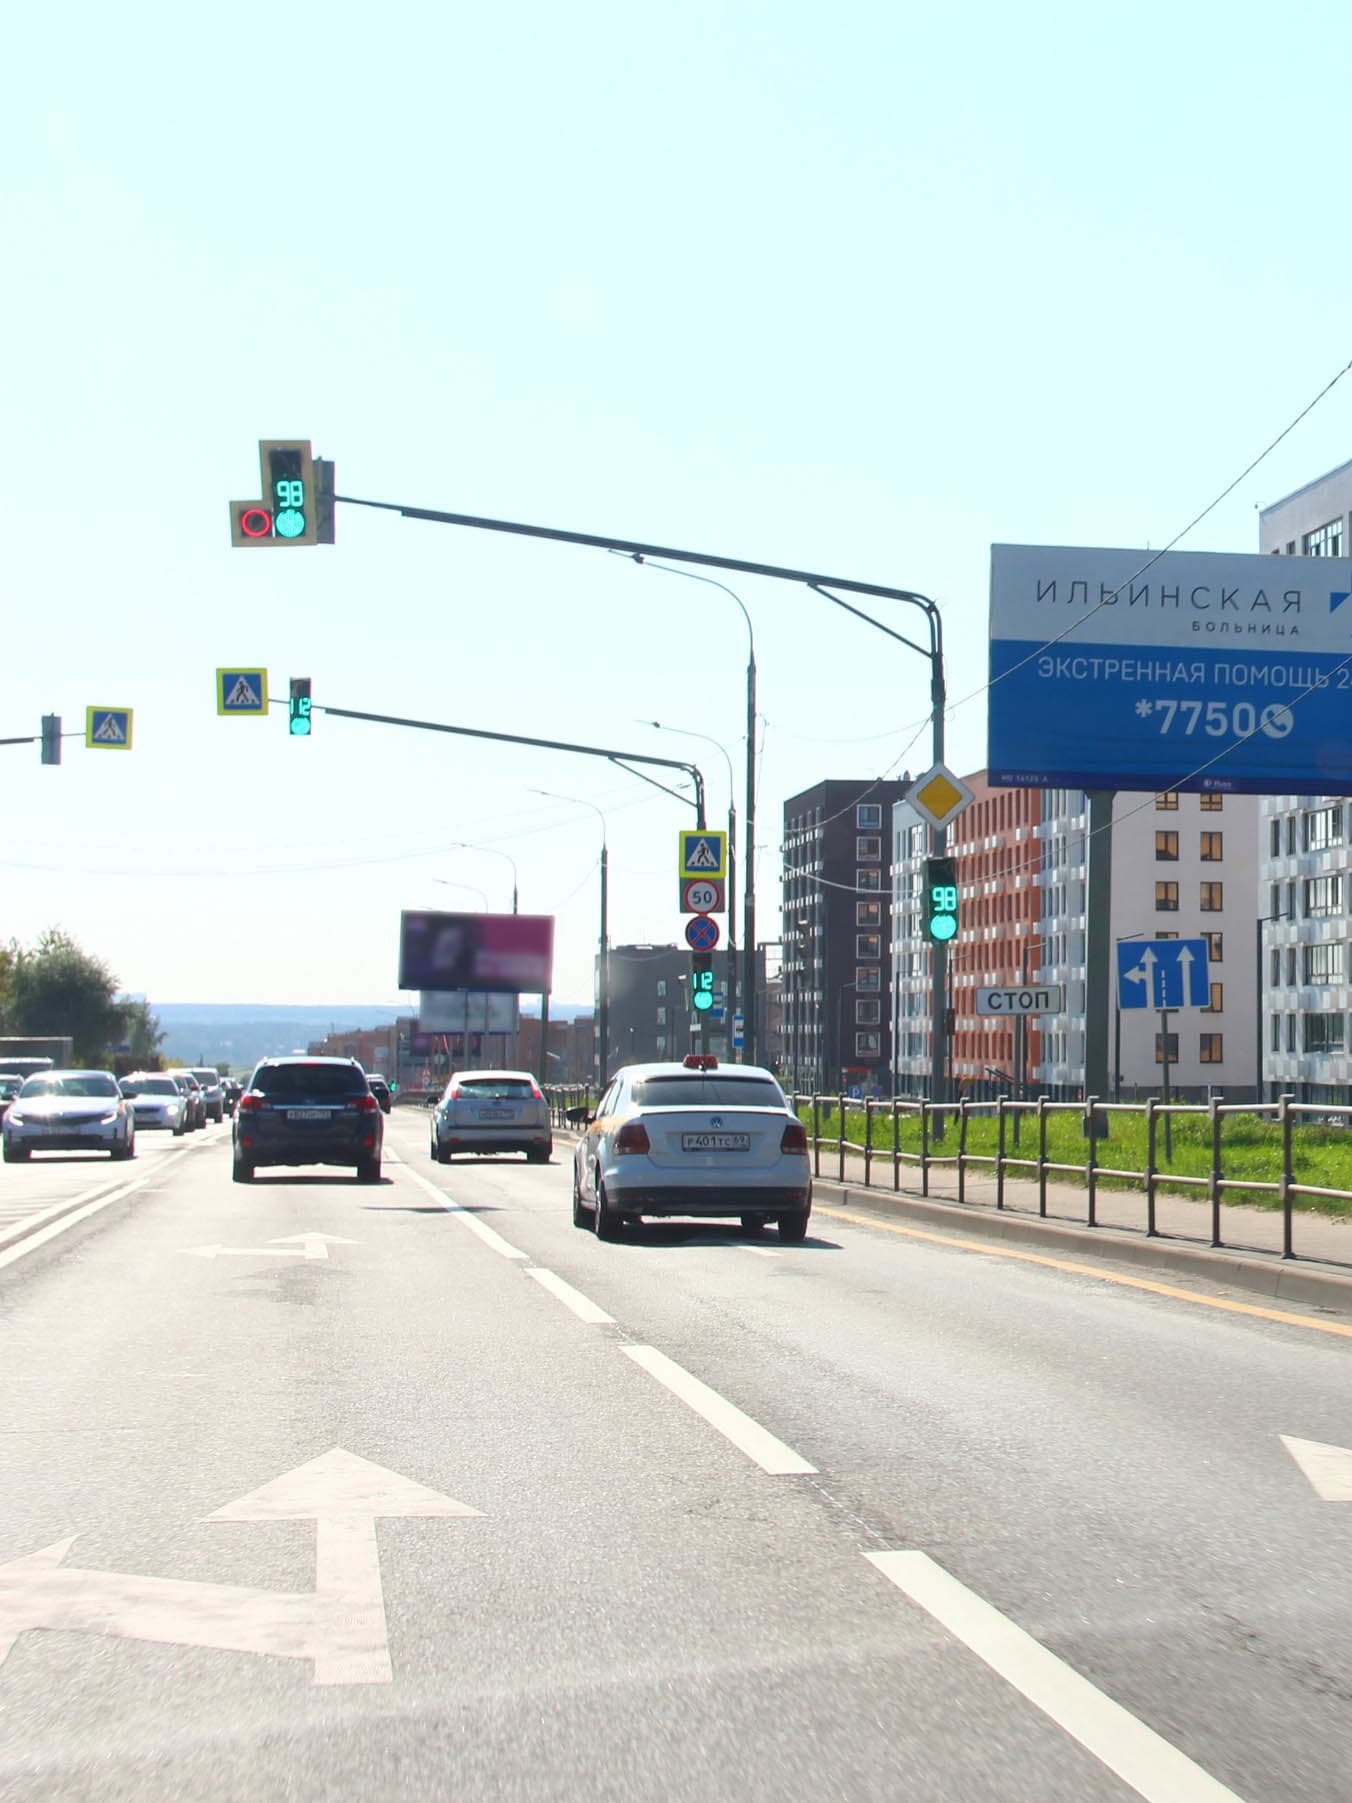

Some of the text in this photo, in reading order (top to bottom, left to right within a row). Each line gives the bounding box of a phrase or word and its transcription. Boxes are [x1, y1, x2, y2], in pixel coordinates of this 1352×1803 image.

[277, 480, 303, 507] 98
[1036, 579, 1301, 614] ИЛЬИНСКАЯ
[1192, 621, 1299, 636] БОЛЬНИЦА
[1037, 657, 1205, 684] ЭКСТРЕННАЯ
[1213, 664, 1329, 689] ПОМОЩЬ
[692, 890, 712, 904] 50
[932, 886, 957, 911] 98
[987, 991, 1049, 1009] СТОП
